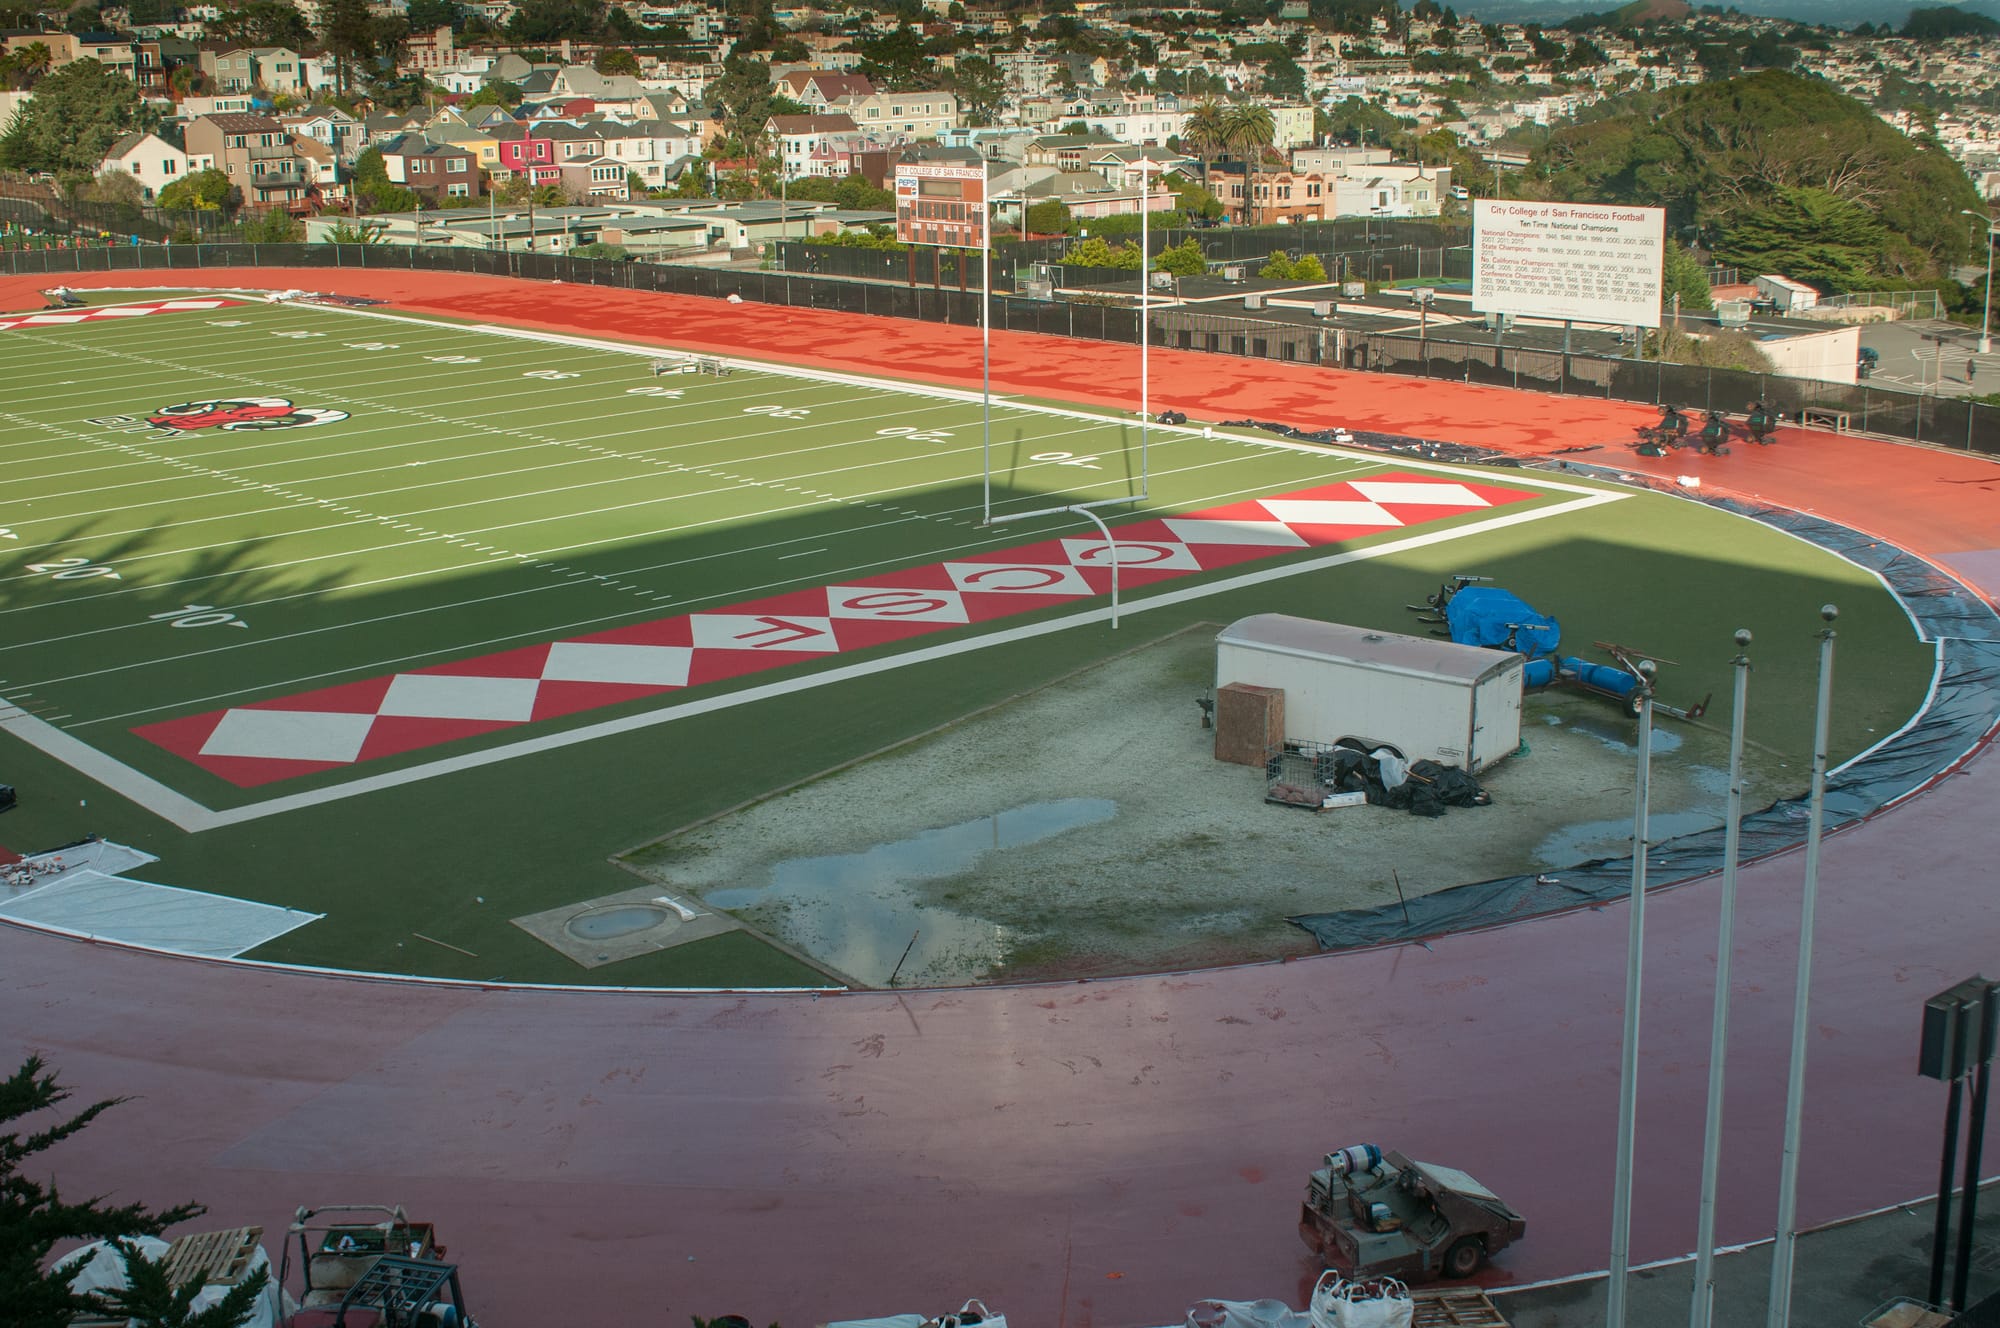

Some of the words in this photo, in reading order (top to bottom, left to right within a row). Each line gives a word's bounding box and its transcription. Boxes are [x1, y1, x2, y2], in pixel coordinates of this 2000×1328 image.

[910, 167, 933, 175] COLLEGE
[956, 169, 983, 177] FRANCISC
[1490, 206, 1506, 215] City
[1509, 207, 1537, 217] College
[1540, 208, 1548, 218] of
[1552, 209, 1567, 218] San
[1570, 210, 1609, 221] Francisco
[1612, 212, 1645, 222] Football
[1551, 222, 1578, 230] National
[1581, 223, 1618, 232] Champions
[1480, 270, 1512, 278] Conference
[522, 370, 581, 380] 50
[626, 386, 686, 398] 40
[742, 404, 812, 418] 30
[876, 426, 956, 442] 20
[1029, 450, 1100, 468] 10
[24, 558, 114, 580] 20
[148, 604, 236, 628] 10
